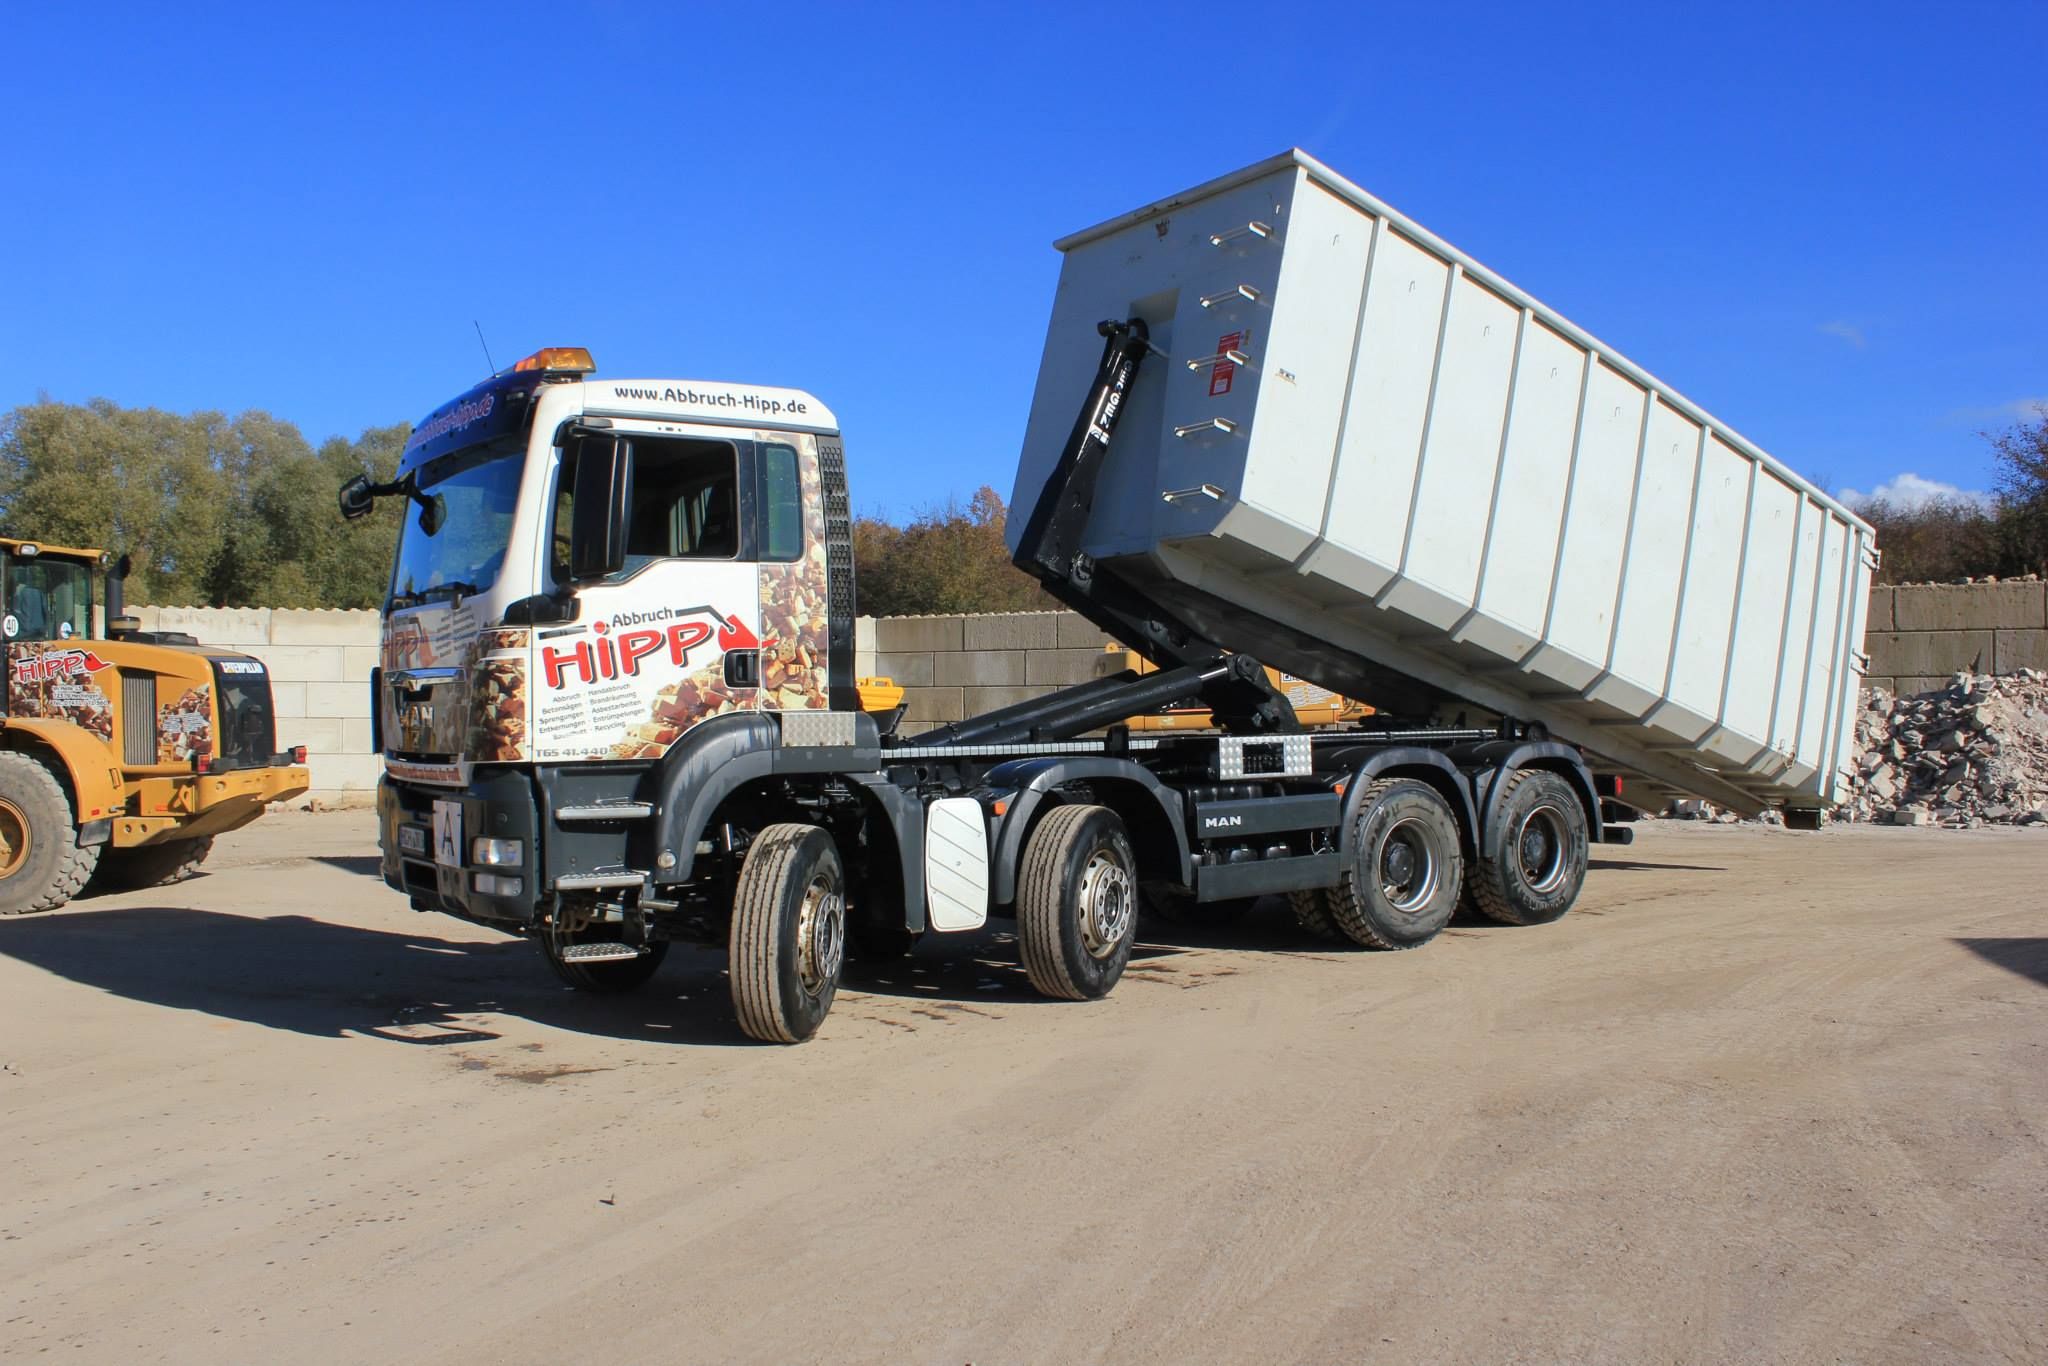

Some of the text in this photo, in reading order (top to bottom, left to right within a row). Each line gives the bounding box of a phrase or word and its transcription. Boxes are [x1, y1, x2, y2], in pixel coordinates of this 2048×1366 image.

[615, 387, 807, 414] www.Abbruch-Hipp.de
[612, 607, 673, 627] Abbruch
[6, 619, 16, 633] 40
[539, 700, 641, 725] Sprengungen Asbestarbeiten
[595, 721, 626, 733] Recycling
[562, 747, 608, 757] 41.440
[1205, 815, 1242, 828] MAN
[442, 810, 455, 856] A
